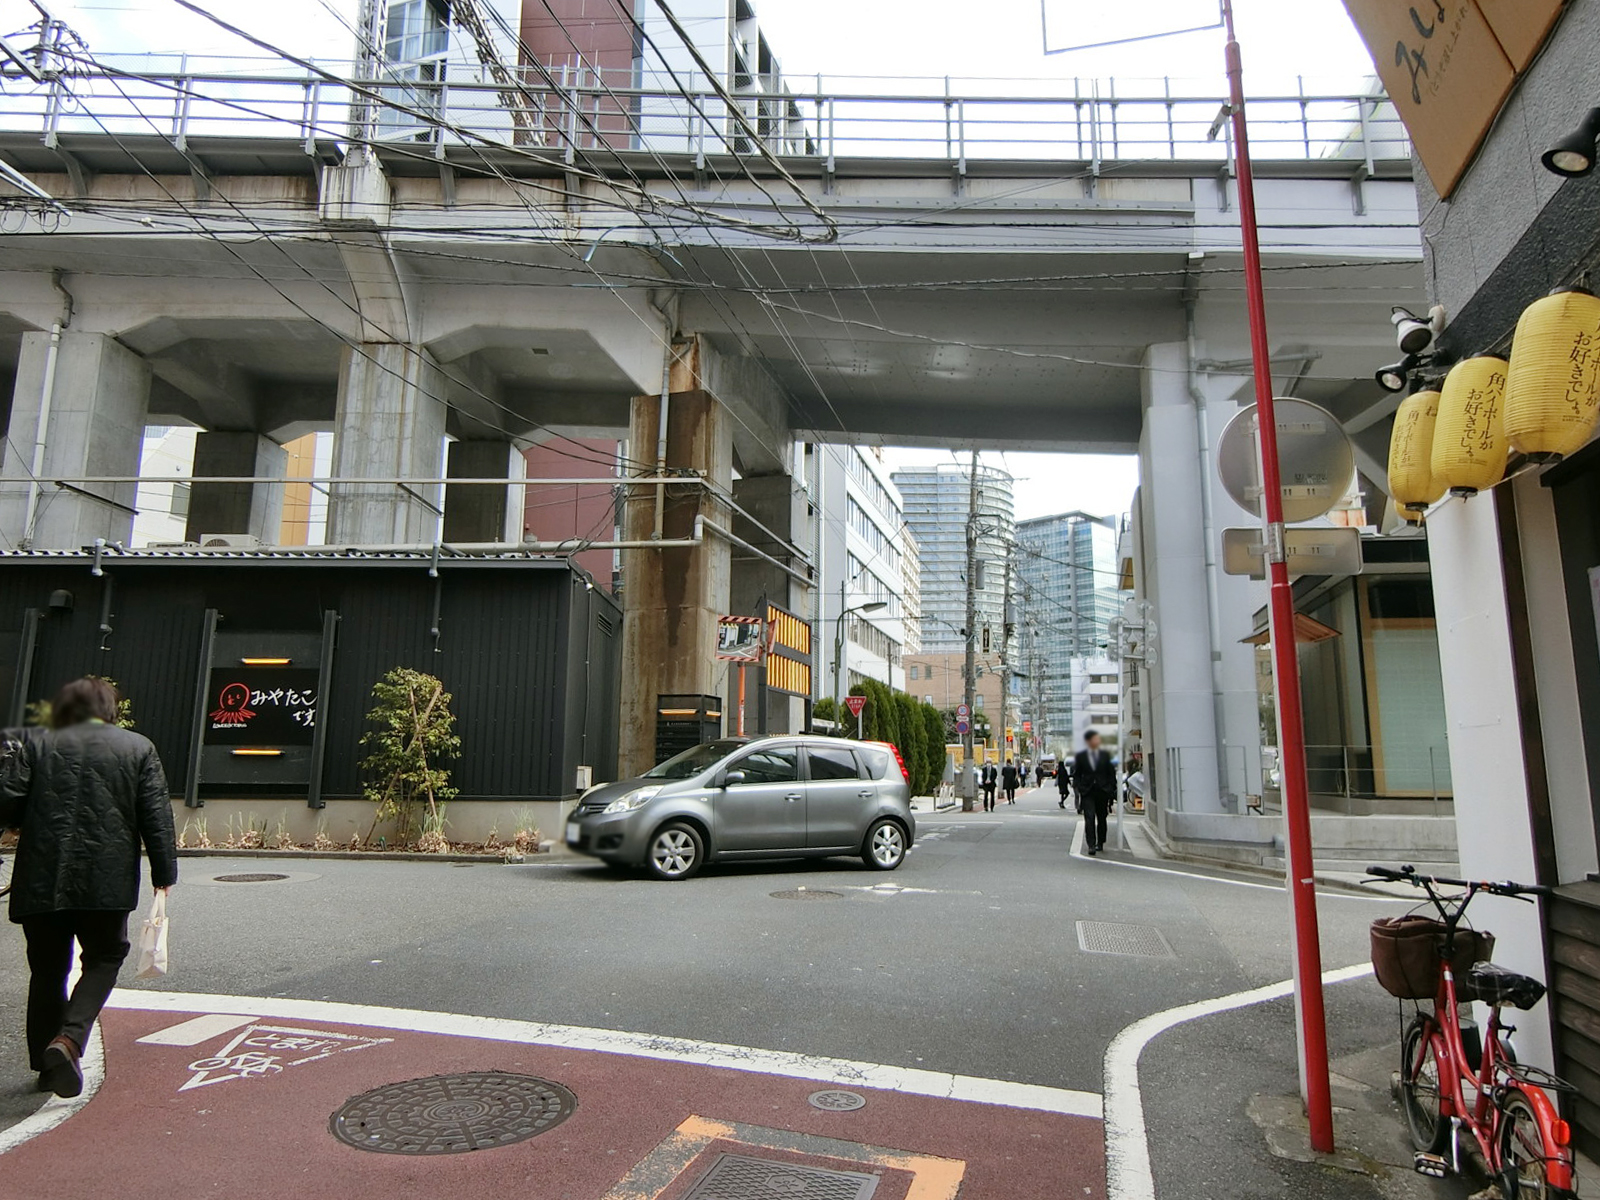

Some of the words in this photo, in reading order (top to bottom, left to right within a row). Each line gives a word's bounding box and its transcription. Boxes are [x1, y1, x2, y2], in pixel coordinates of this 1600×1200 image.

[1478, 372, 1506, 451] 角ハイボールが
[250, 687, 318, 706] みやたこ
[292, 708, 316, 727] です。
